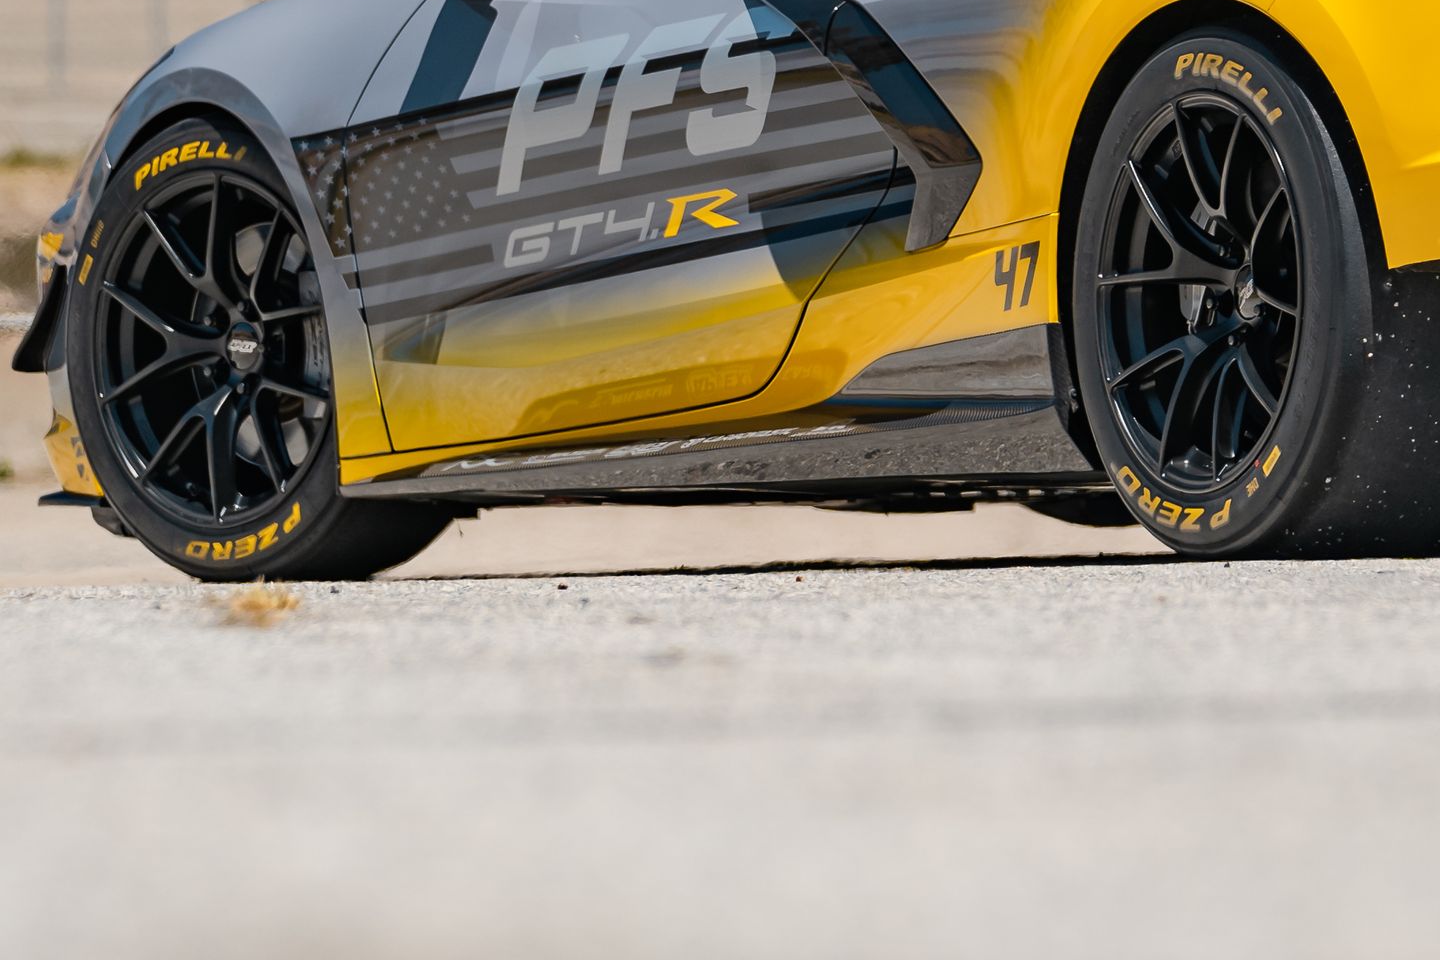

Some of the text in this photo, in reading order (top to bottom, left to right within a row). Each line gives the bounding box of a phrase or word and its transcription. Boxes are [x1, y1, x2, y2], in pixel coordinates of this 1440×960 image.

[496, 6, 800, 197] PFS
[1174, 52, 1283, 126] PIRELLI
[133, 140, 247, 191] PIRELLI
[994, 240, 1041, 312] 47
[185, 501, 301, 560] P ZERO
[1115, 465, 1232, 531] P ZERO
